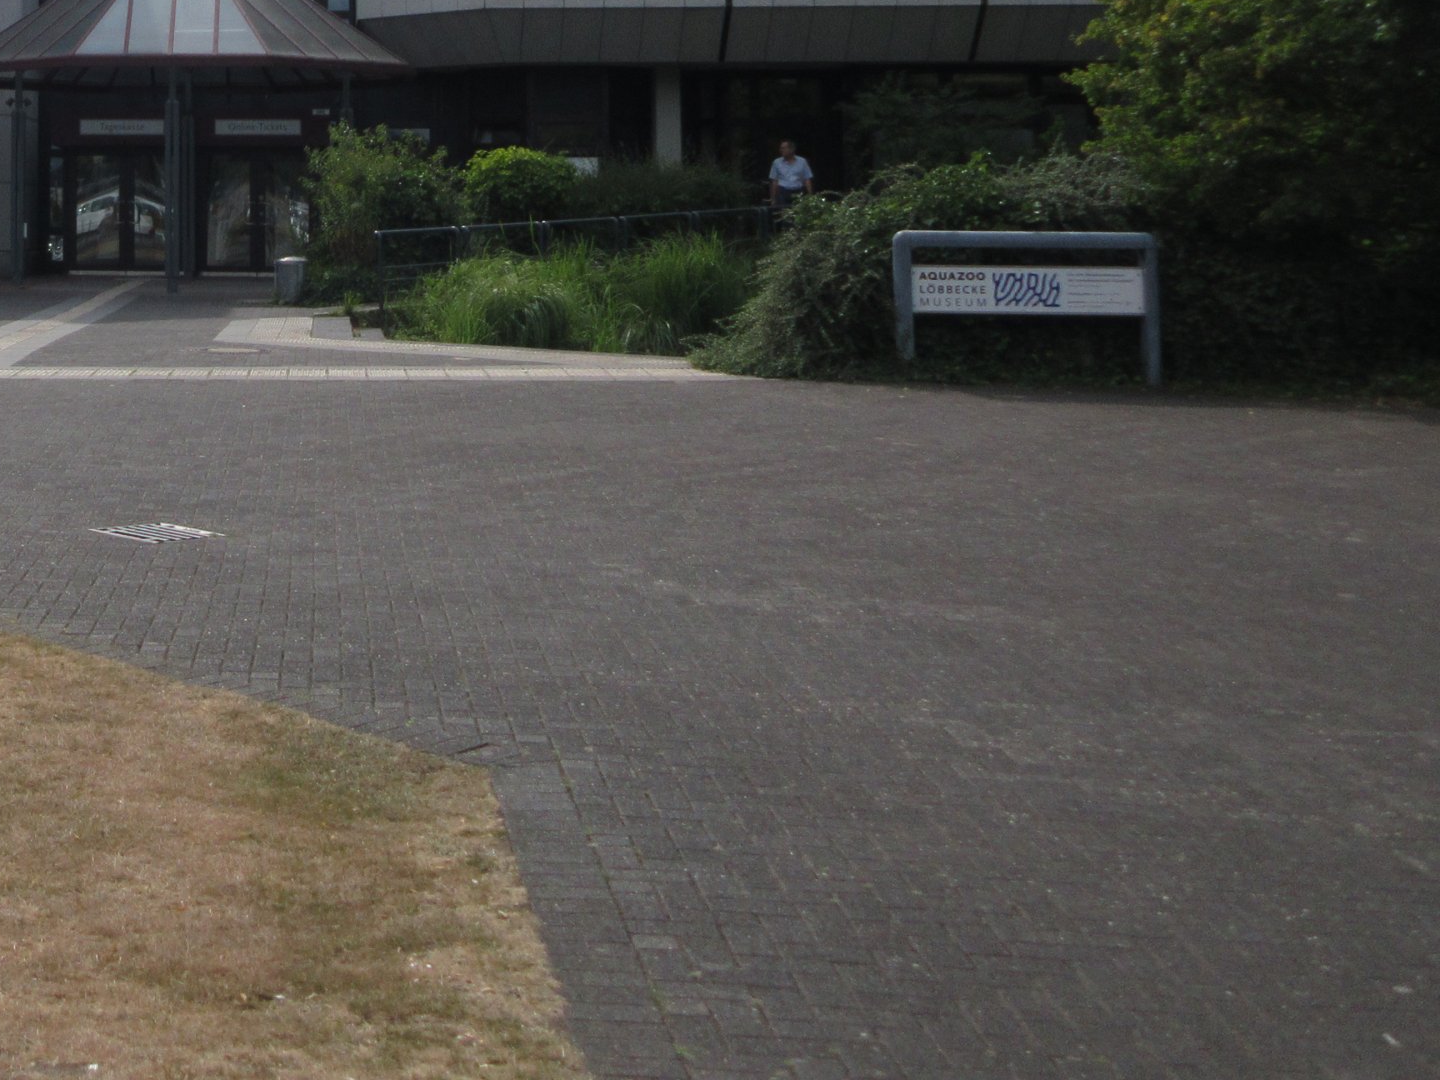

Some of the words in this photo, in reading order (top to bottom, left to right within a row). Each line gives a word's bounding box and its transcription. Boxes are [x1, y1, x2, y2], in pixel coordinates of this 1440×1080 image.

[919, 271, 985, 281] AQUAZOO
[919, 283, 987, 294] LÖBBECKE
[920, 297, 987, 307] MUSEUM
